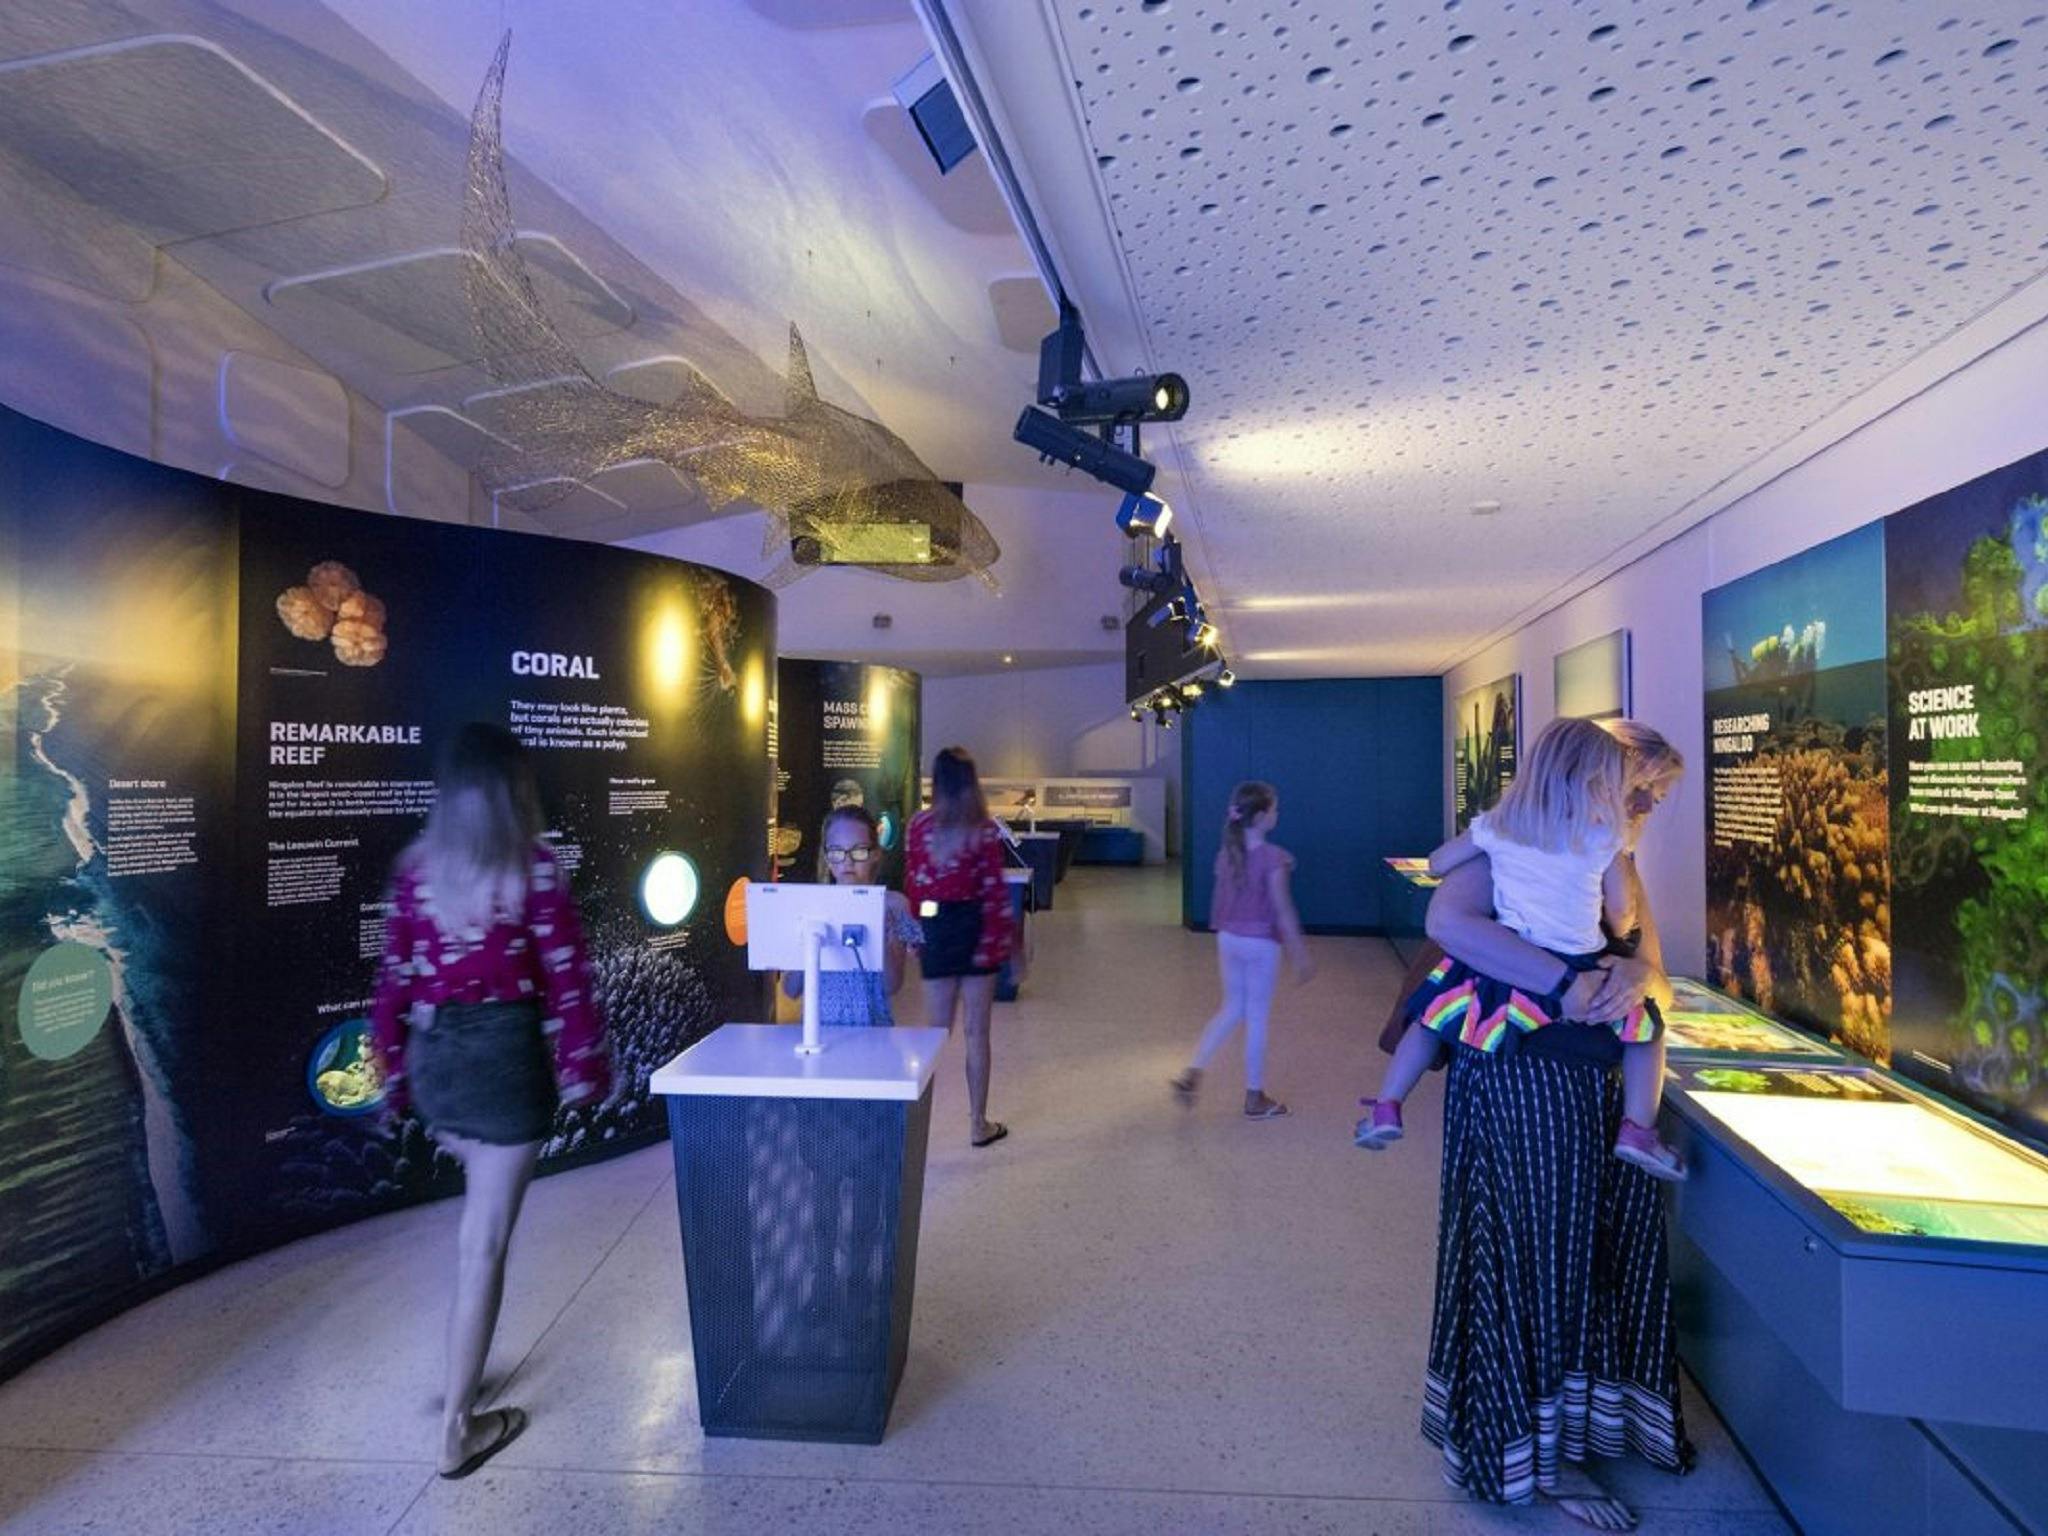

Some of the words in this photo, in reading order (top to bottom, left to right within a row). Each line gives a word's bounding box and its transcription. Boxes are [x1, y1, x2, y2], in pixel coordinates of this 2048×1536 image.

[511, 650, 601, 679] CORAL
[1908, 684, 1975, 714] SCIENCE
[510, 700, 534, 712] They
[537, 702, 559, 714] may
[560, 702, 580, 713] look
[581, 703, 597, 713] like
[823, 701, 858, 714] MASS
[510, 711, 530, 723] but
[531, 713, 560, 725] corals
[563, 716, 579, 725] are
[580, 716, 614, 728] actually
[1908, 717, 1926, 740] AT
[1929, 711, 1980, 740] WORK
[270, 721, 421, 744] REMARKABLE
[510, 725, 523, 734] of
[524, 726, 545, 736] tiny
[546, 726, 584, 736] animals.
[586, 727, 608, 737] Each
[609, 729, 649, 738] individual
[540, 738, 549, 747] is
[550, 738, 580, 748] known
[603, 740, 628, 750] polyp.
[270, 745, 326, 765] REEF
[109, 779, 139, 788] Desert
[141, 779, 166, 788] shore
[268, 842, 285, 851] The
[325, 838, 359, 848] Current
[317, 1003, 341, 1014] What
[343, 1001, 360, 1009] can
